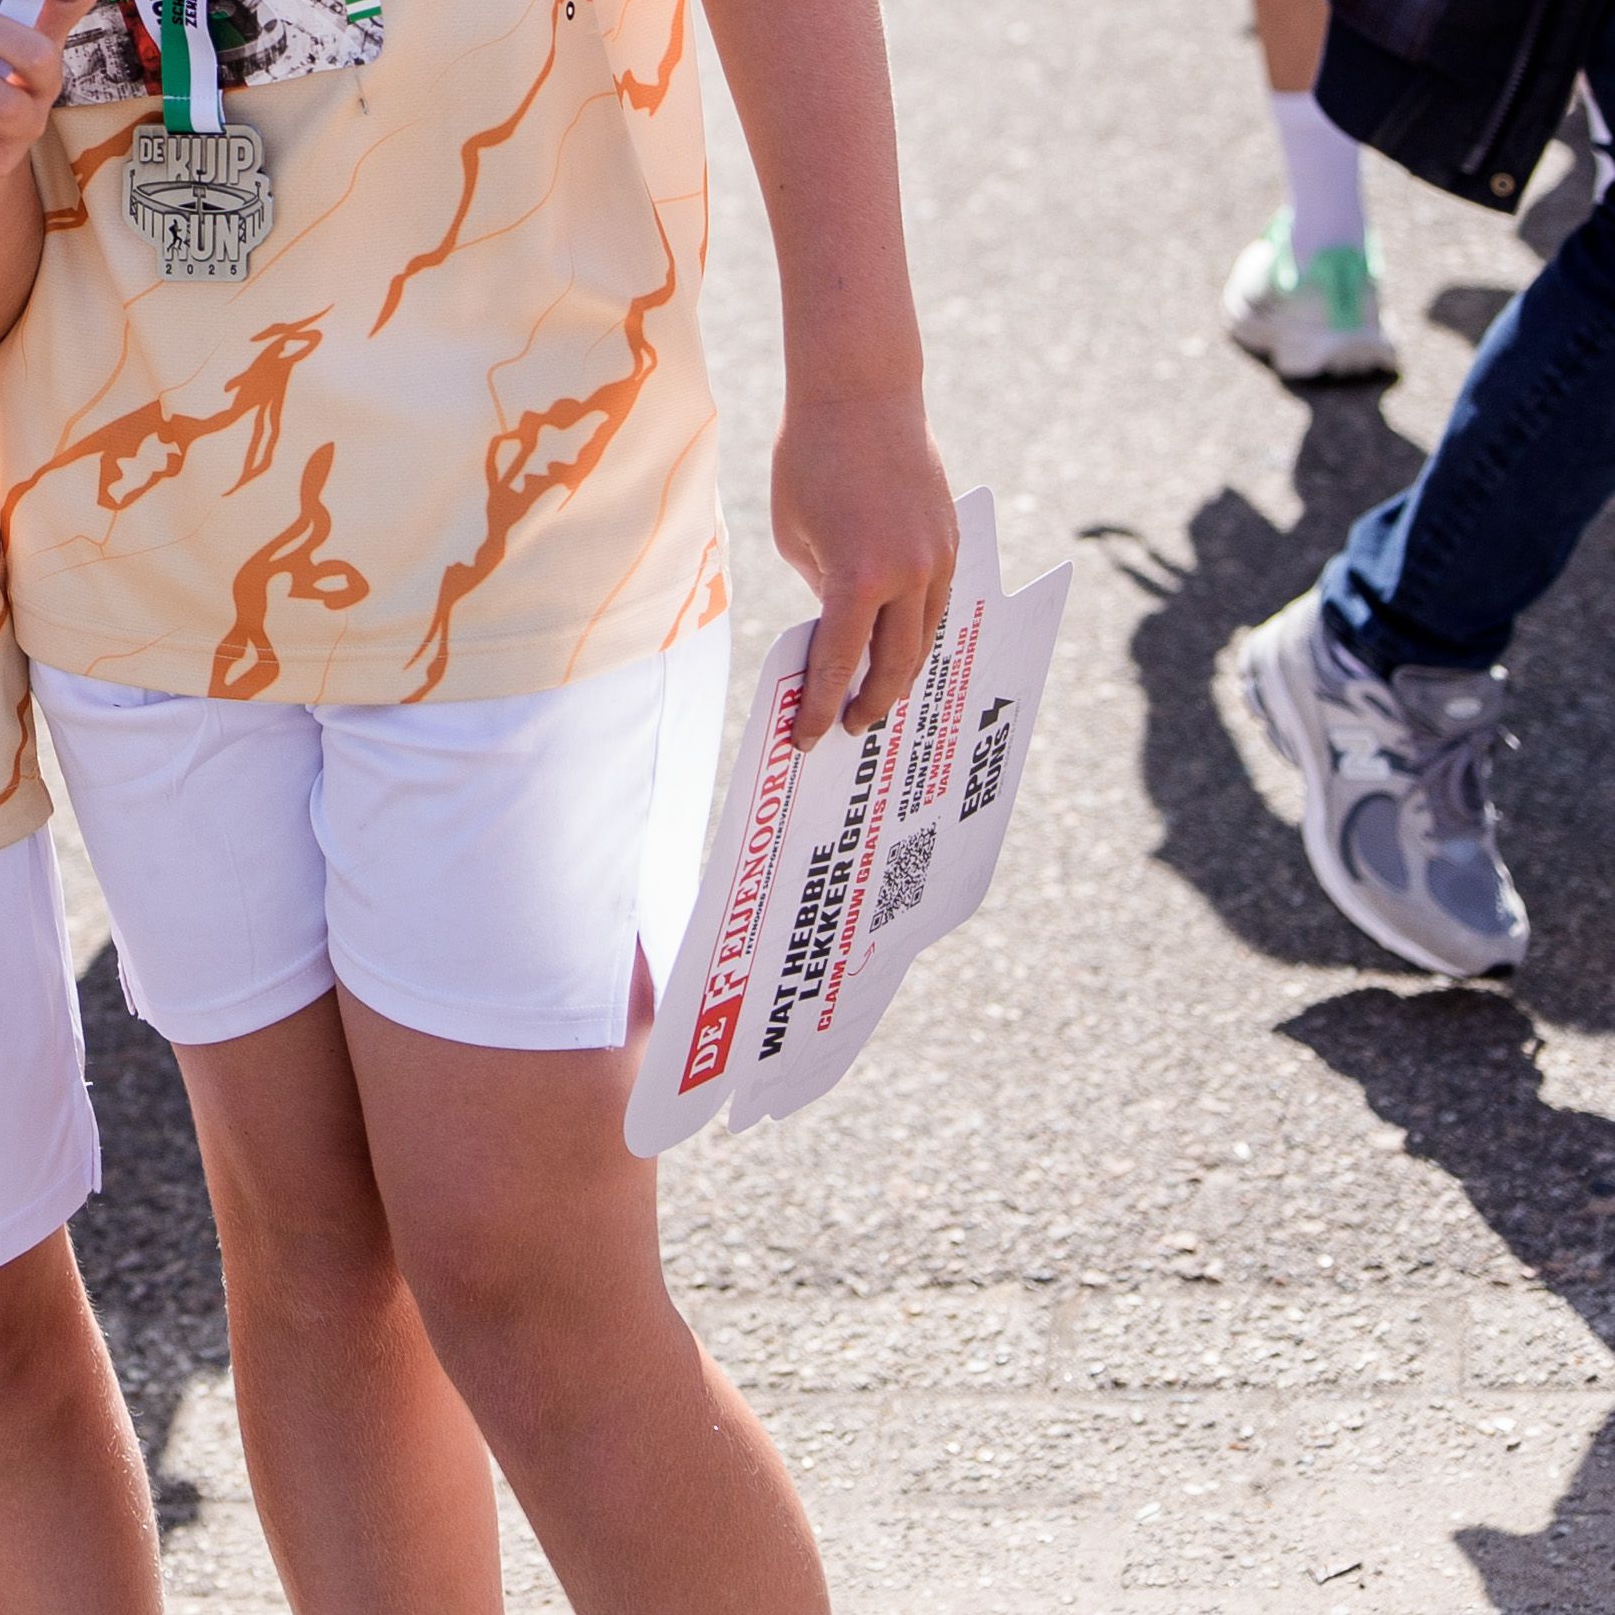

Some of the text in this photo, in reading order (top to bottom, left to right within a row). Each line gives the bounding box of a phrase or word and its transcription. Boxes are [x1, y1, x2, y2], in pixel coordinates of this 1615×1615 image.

[139, 136, 255, 186] DE KUIP
[164, 213, 240, 262] RUN
[910, 654, 951, 814] SCAN DE QR-CODE
[923, 627, 968, 805] EN WORD GRATIS LID
[937, 762, 951, 797] VAN
[945, 736, 957, 760] DE
[959, 735, 993, 822] EPIC
[980, 722, 1010, 809] RUNS
[797, 711, 889, 1002] LEKKER GELOP
[816, 695, 911, 1033] CLAIM JOUW GRATIS LIDMAAT
[745, 893, 767, 955] FEYENOORD
[758, 840, 836, 1062] WAT HEBBIE
[690, 1015, 727, 1081] DE
